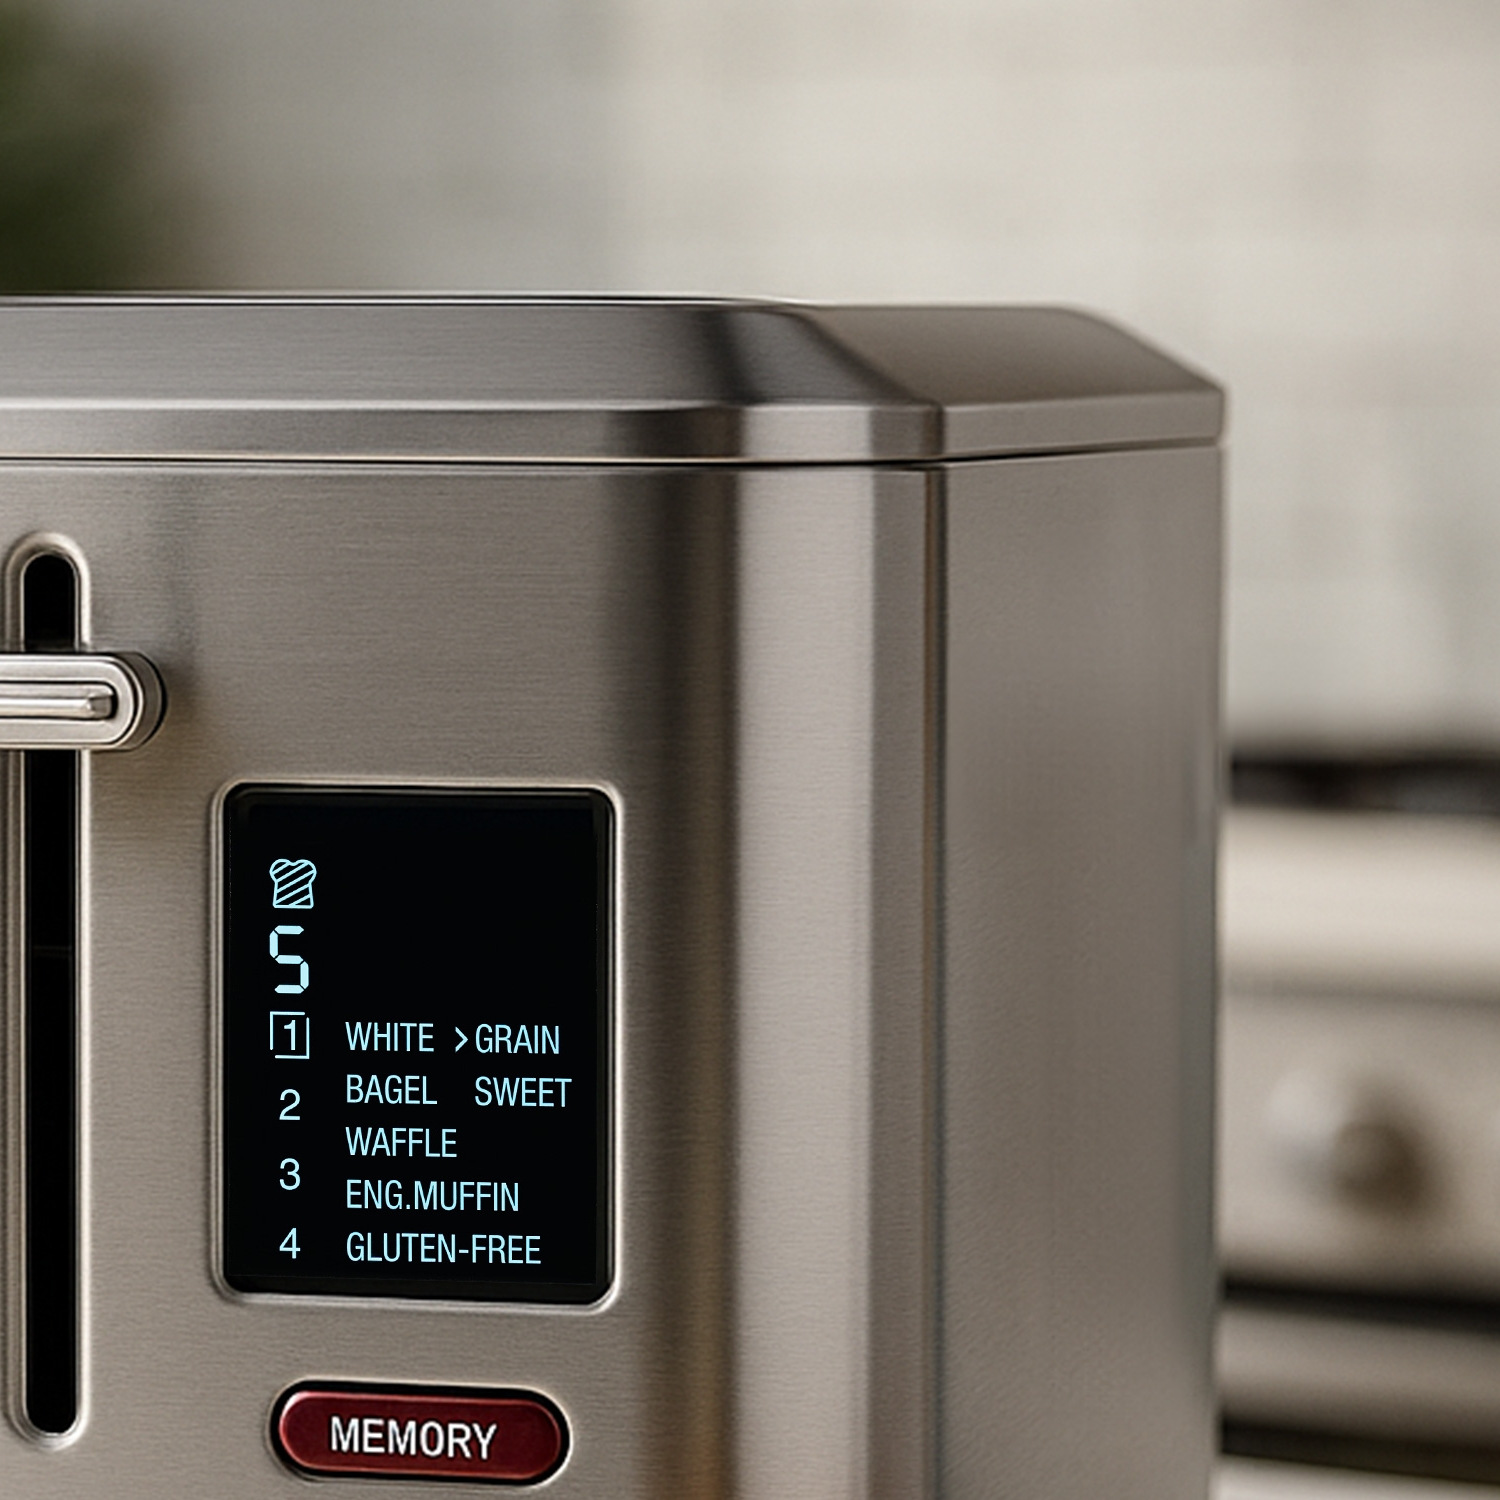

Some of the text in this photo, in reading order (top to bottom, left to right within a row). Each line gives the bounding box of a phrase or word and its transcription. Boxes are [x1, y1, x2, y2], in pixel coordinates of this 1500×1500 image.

[283, 1020, 297, 1051] 1
[345, 1022, 434, 1052] WHITE
[475, 1024, 560, 1054] GRAIN
[279, 1089, 301, 1121] 2
[346, 1075, 438, 1105] BAGEL
[474, 1076, 572, 1108] SWEET
[346, 1127, 457, 1158] WAFFLE
[279, 1158, 301, 1190] 3
[347, 1180, 519, 1212] ENG.MUFFIN
[279, 1228, 301, 1259] 4
[346, 1232, 542, 1265] GLUTEN-FREE
[330, 1416, 497, 1459] MEMORY
